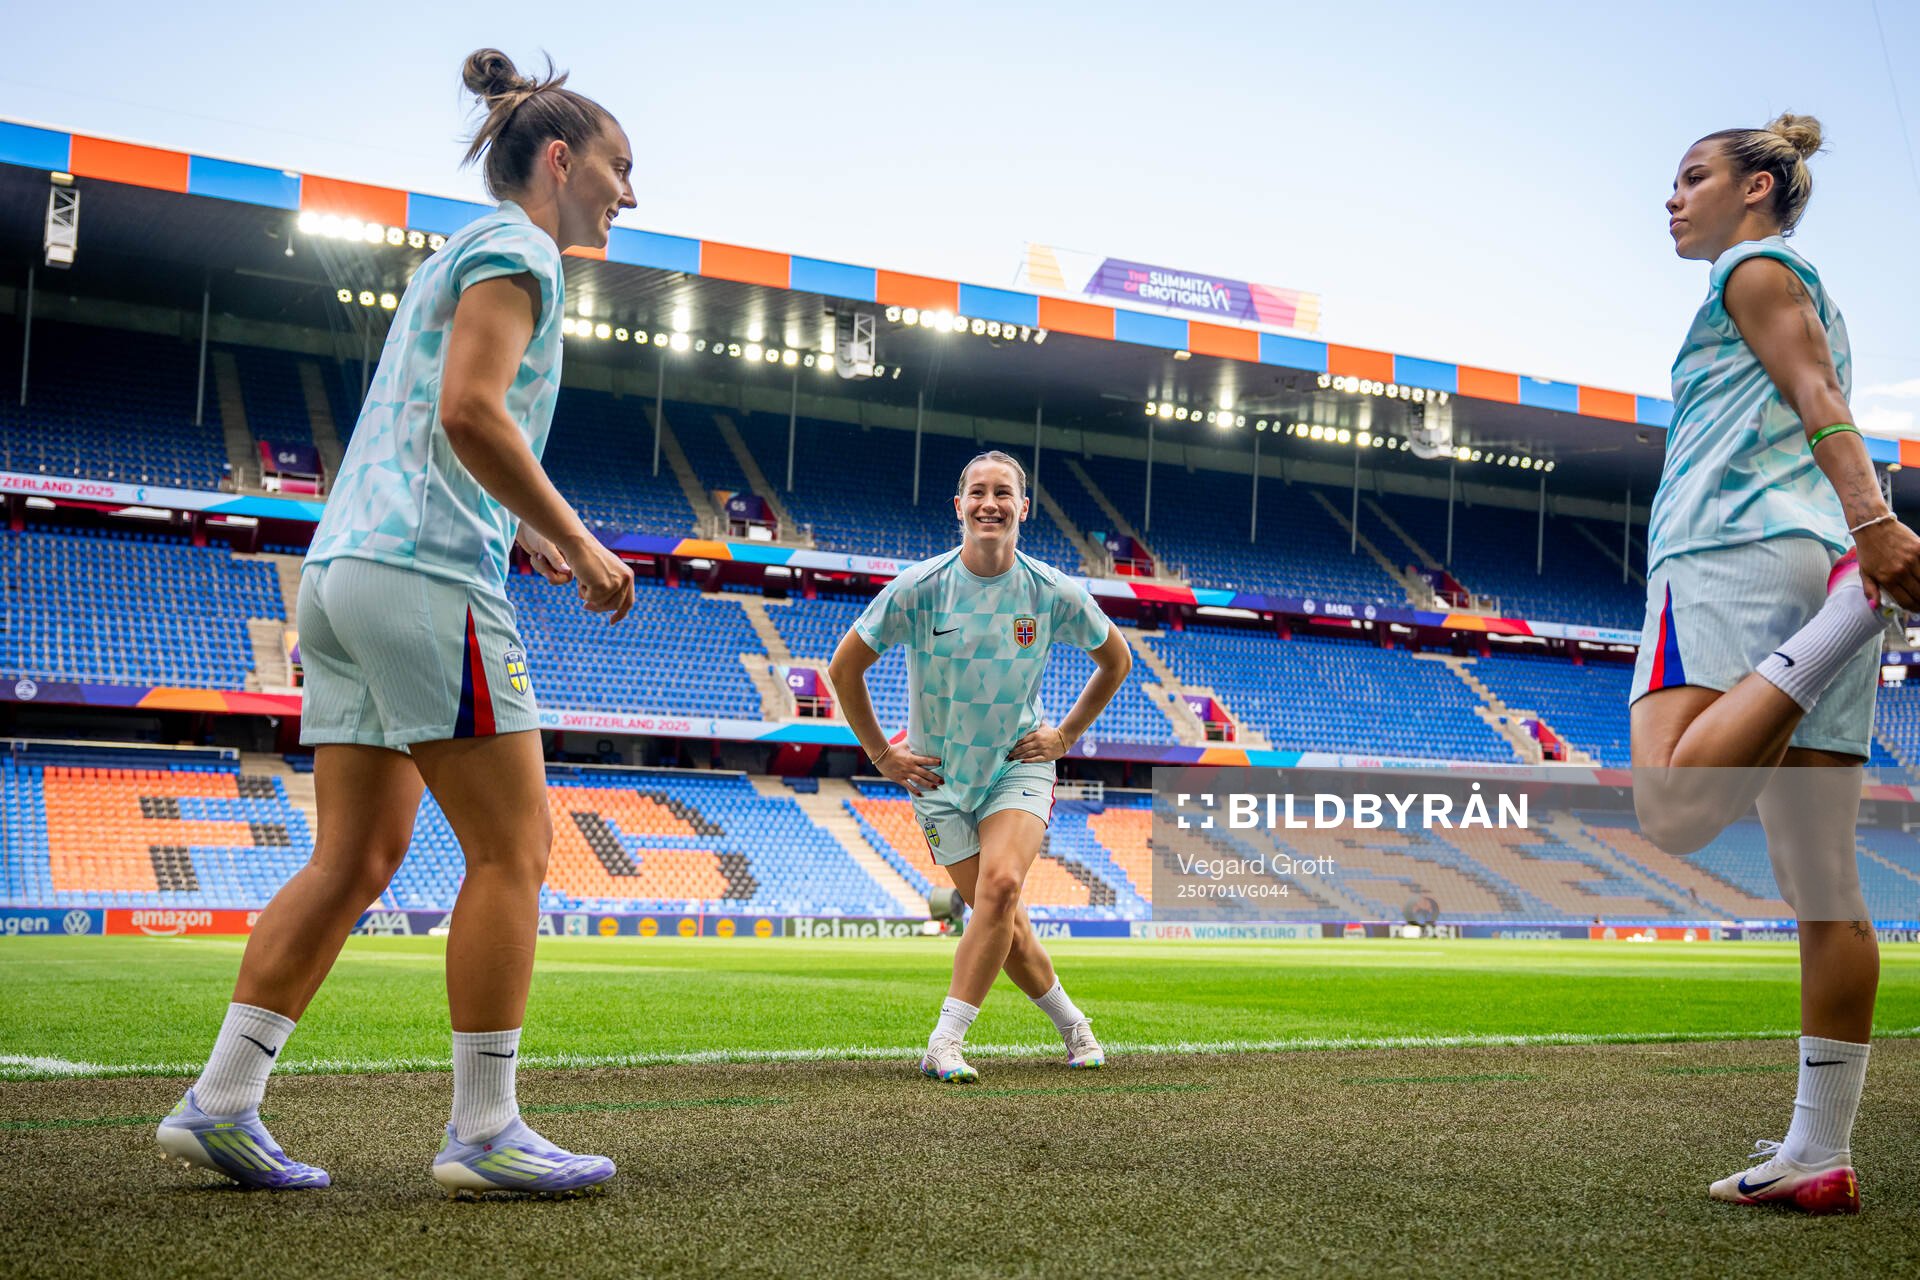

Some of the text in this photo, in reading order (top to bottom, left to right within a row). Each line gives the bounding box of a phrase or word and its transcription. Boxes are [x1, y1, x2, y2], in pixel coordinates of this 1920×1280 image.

[1138, 283, 1210, 309] EMOTIONS
[0, 475, 115, 498] ZERLAND 2025
[1325, 603, 1355, 617] BASEL
[563, 714, 654, 730] SWITZERLAND
[657, 722, 691, 732] 2025
[0, 917, 49, 935] gen
[132, 910, 213, 928] amazon
[1031, 922, 1072, 938] VISA
[1155, 926, 1191, 938] UEFA
[1260, 927, 1296, 938] EURO
